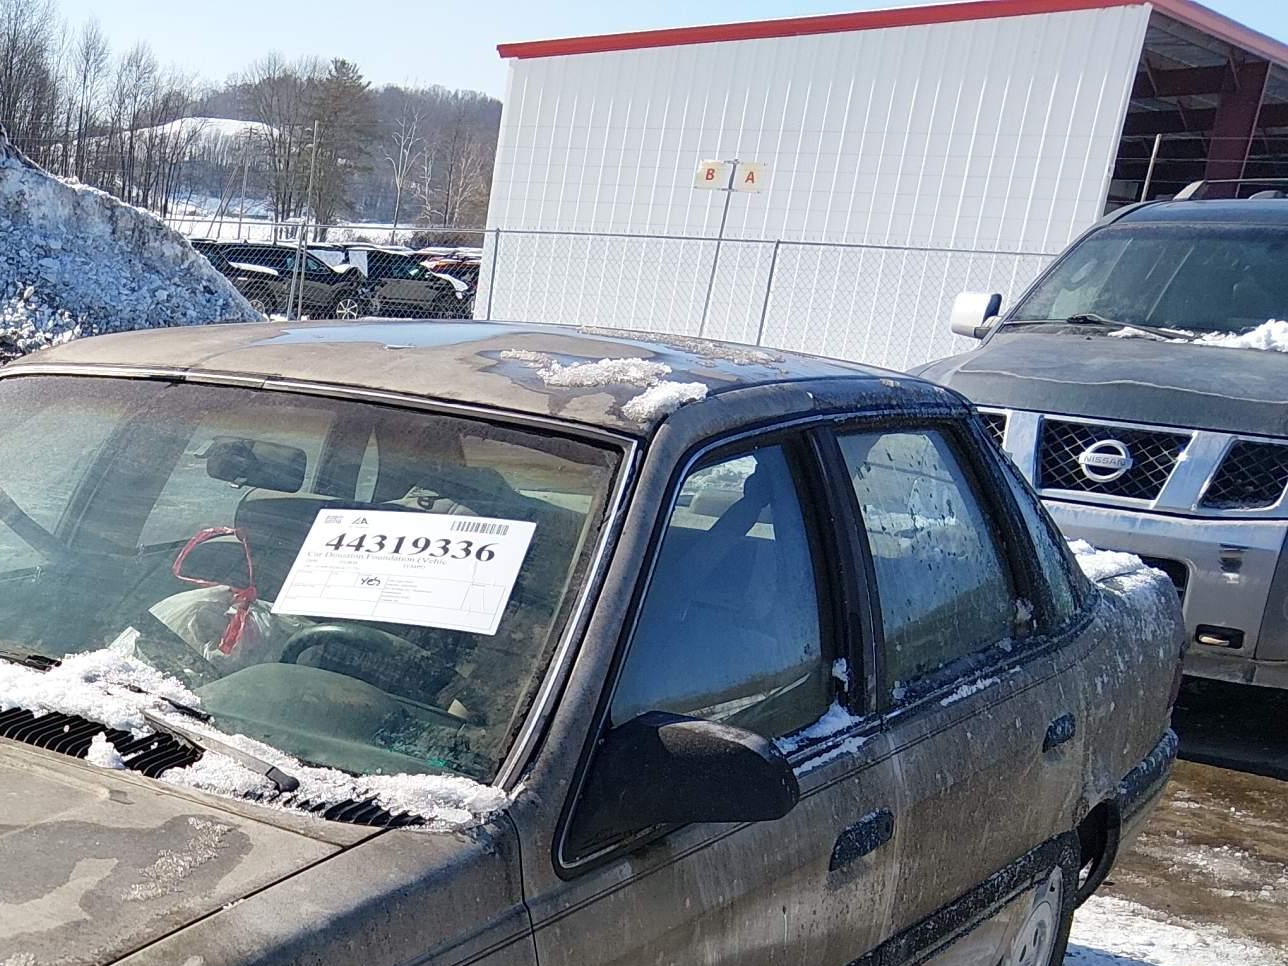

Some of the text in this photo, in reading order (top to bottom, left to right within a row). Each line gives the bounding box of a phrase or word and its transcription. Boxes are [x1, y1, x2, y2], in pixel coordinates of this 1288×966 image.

[705, 167, 716, 181] B
[744, 170, 755, 184] A
[1083, 455, 1127, 467] NISSAN
[324, 532, 501, 562] 44319336
